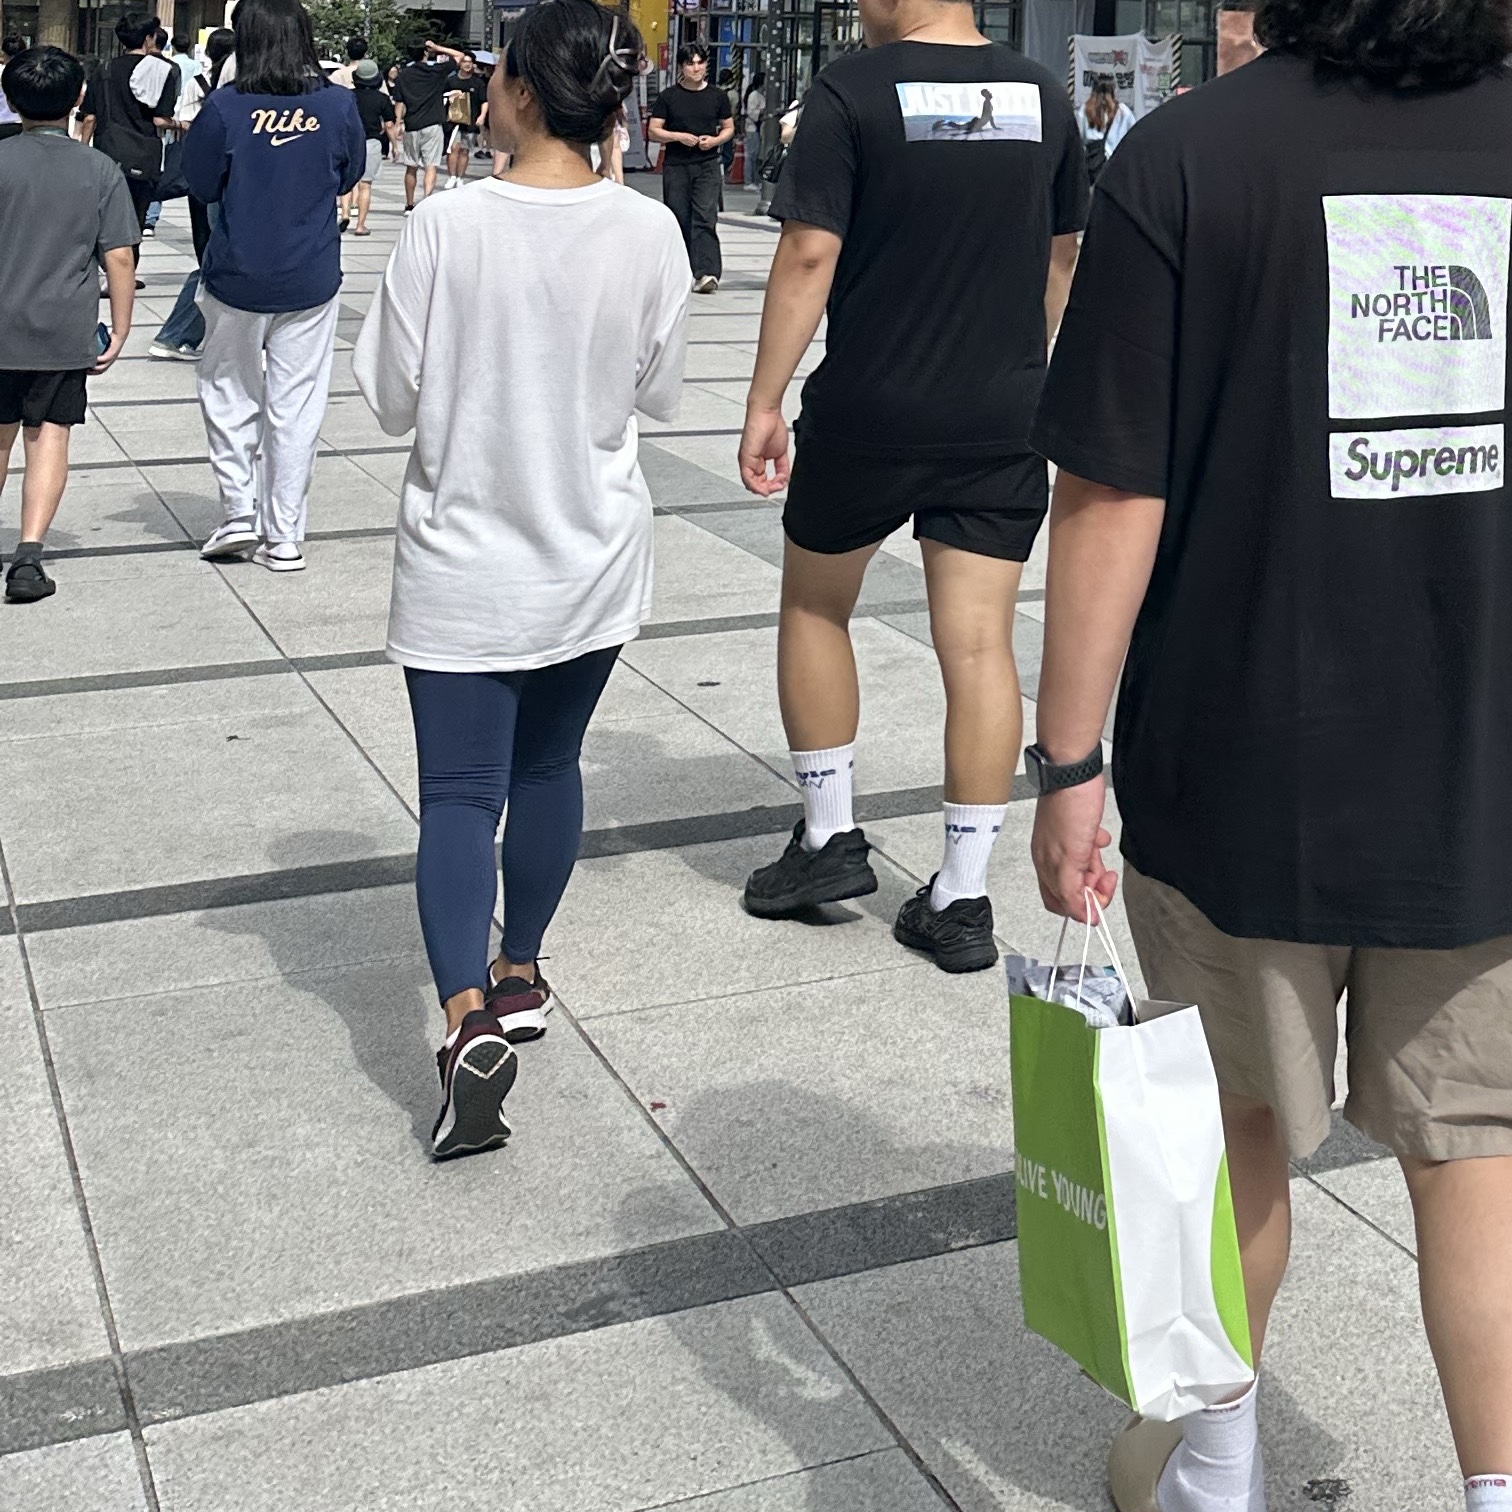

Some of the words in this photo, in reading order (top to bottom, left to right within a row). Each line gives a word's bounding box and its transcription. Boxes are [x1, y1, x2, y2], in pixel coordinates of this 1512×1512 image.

[251, 108, 321, 135] Nike
[1393, 265, 1449, 289] THE
[1351, 289, 1449, 319] NORTH
[1377, 315, 1449, 343] FACE
[1344, 437, 1499, 492] Supreme
[1050, 1169, 1107, 1231] YOUNG
